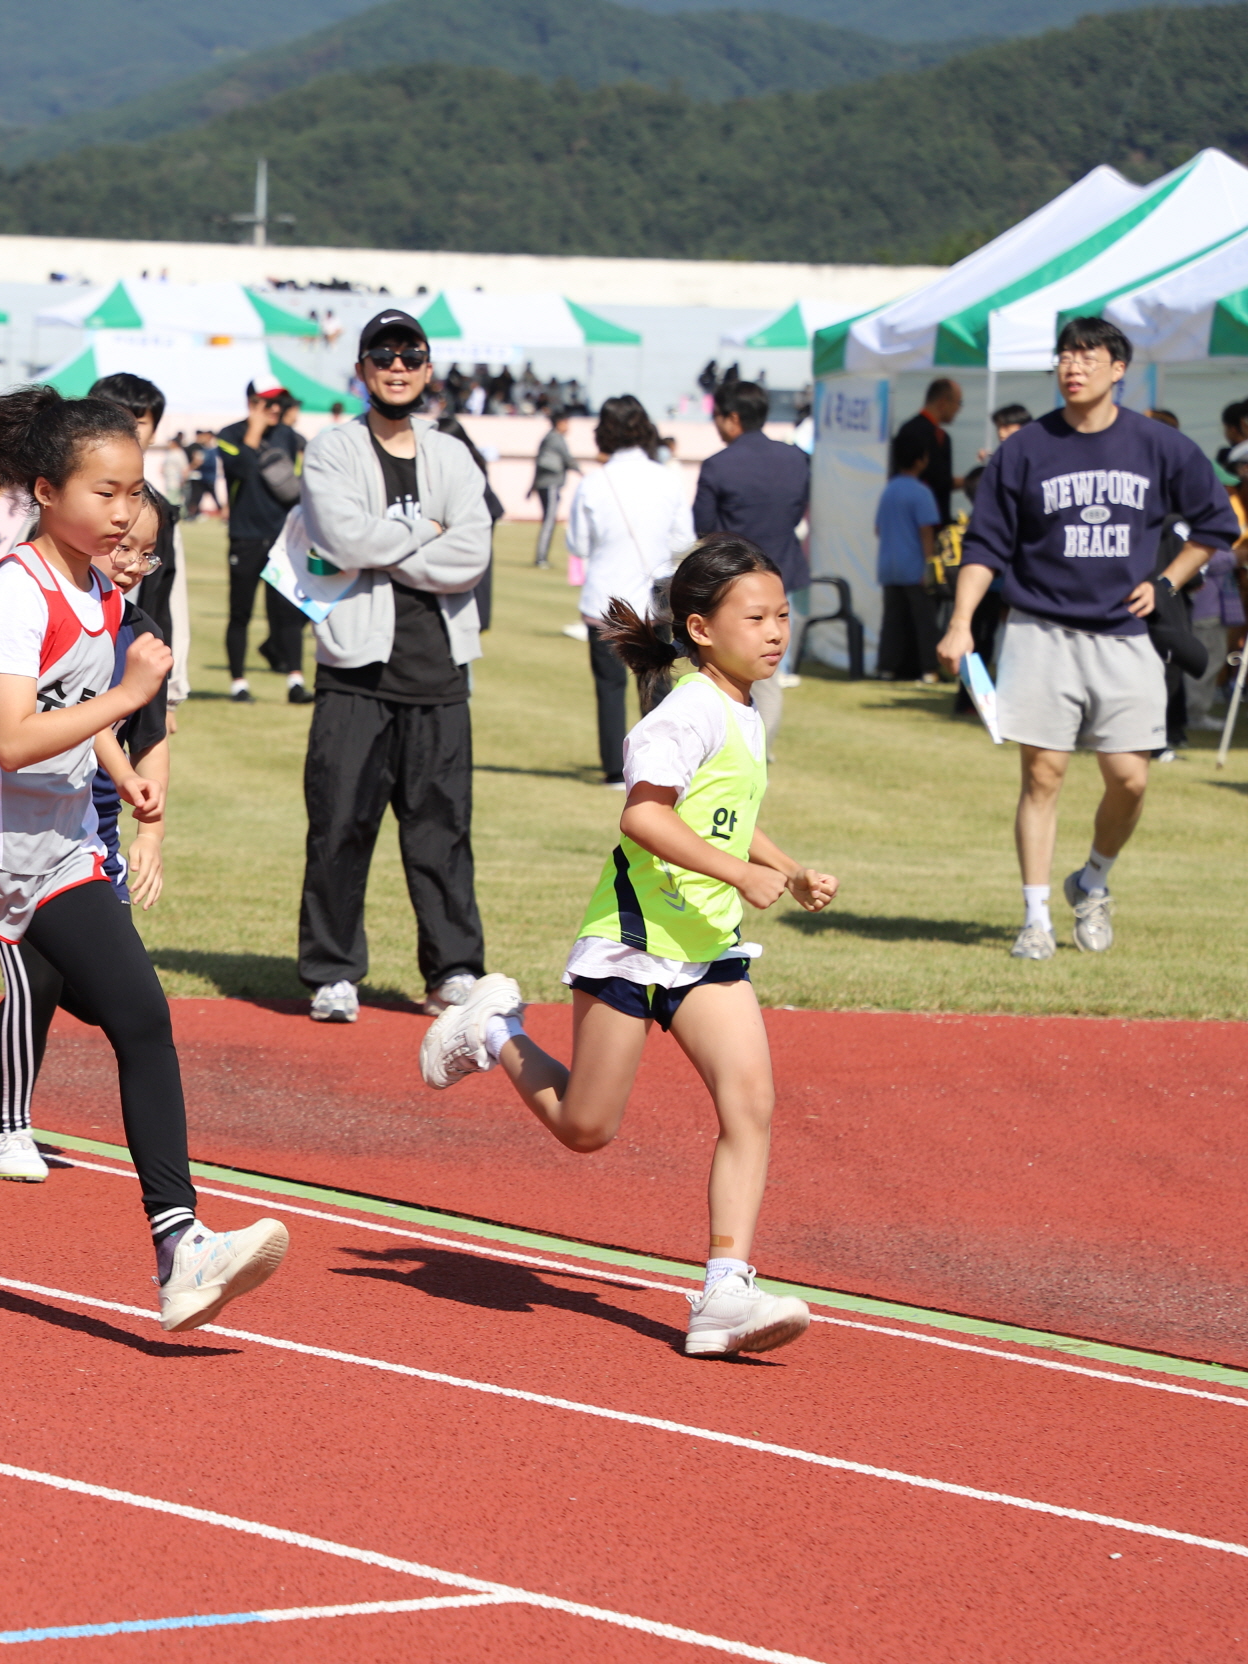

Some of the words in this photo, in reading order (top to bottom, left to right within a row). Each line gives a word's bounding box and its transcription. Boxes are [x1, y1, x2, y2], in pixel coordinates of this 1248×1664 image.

[1041, 469, 1150, 515] NEWPORT
[1064, 524, 1130, 558] BEACH
[711, 807, 738, 841] 안
